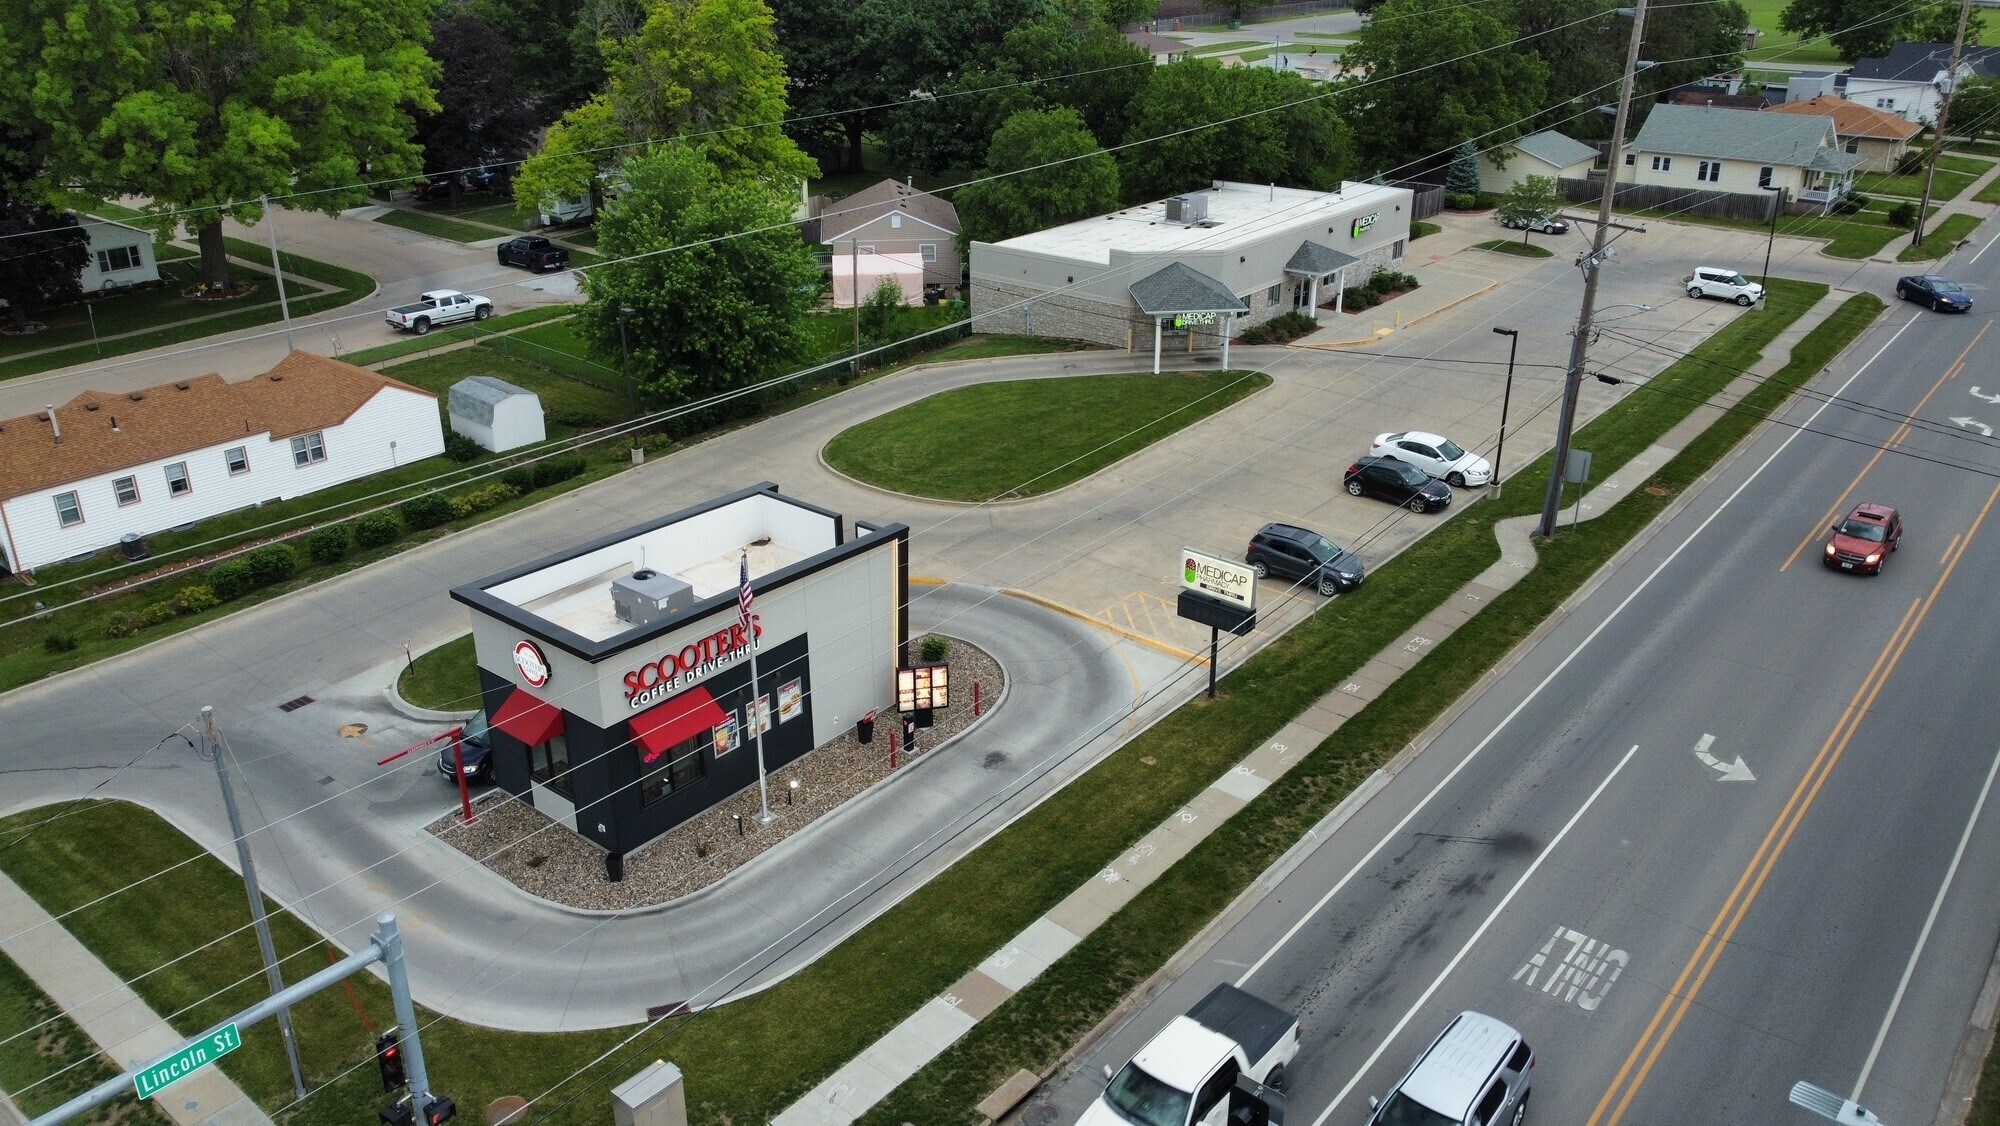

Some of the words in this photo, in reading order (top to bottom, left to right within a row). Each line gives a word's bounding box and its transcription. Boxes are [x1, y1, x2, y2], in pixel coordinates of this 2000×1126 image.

[1182, 312, 1216, 320] MEDICAP
[1197, 563, 1248, 586] MEDICAP
[1197, 573, 1230, 589] PHARMACY
[624, 614, 764, 698] SCOOTERS
[630, 677, 680, 709] COFFEE
[687, 639, 761, 683] DRIVE-THRU
[1513, 926, 1630, 1011] ONLY
[141, 1047, 207, 1093] Lincoln
[213, 1030, 234, 1053] St
